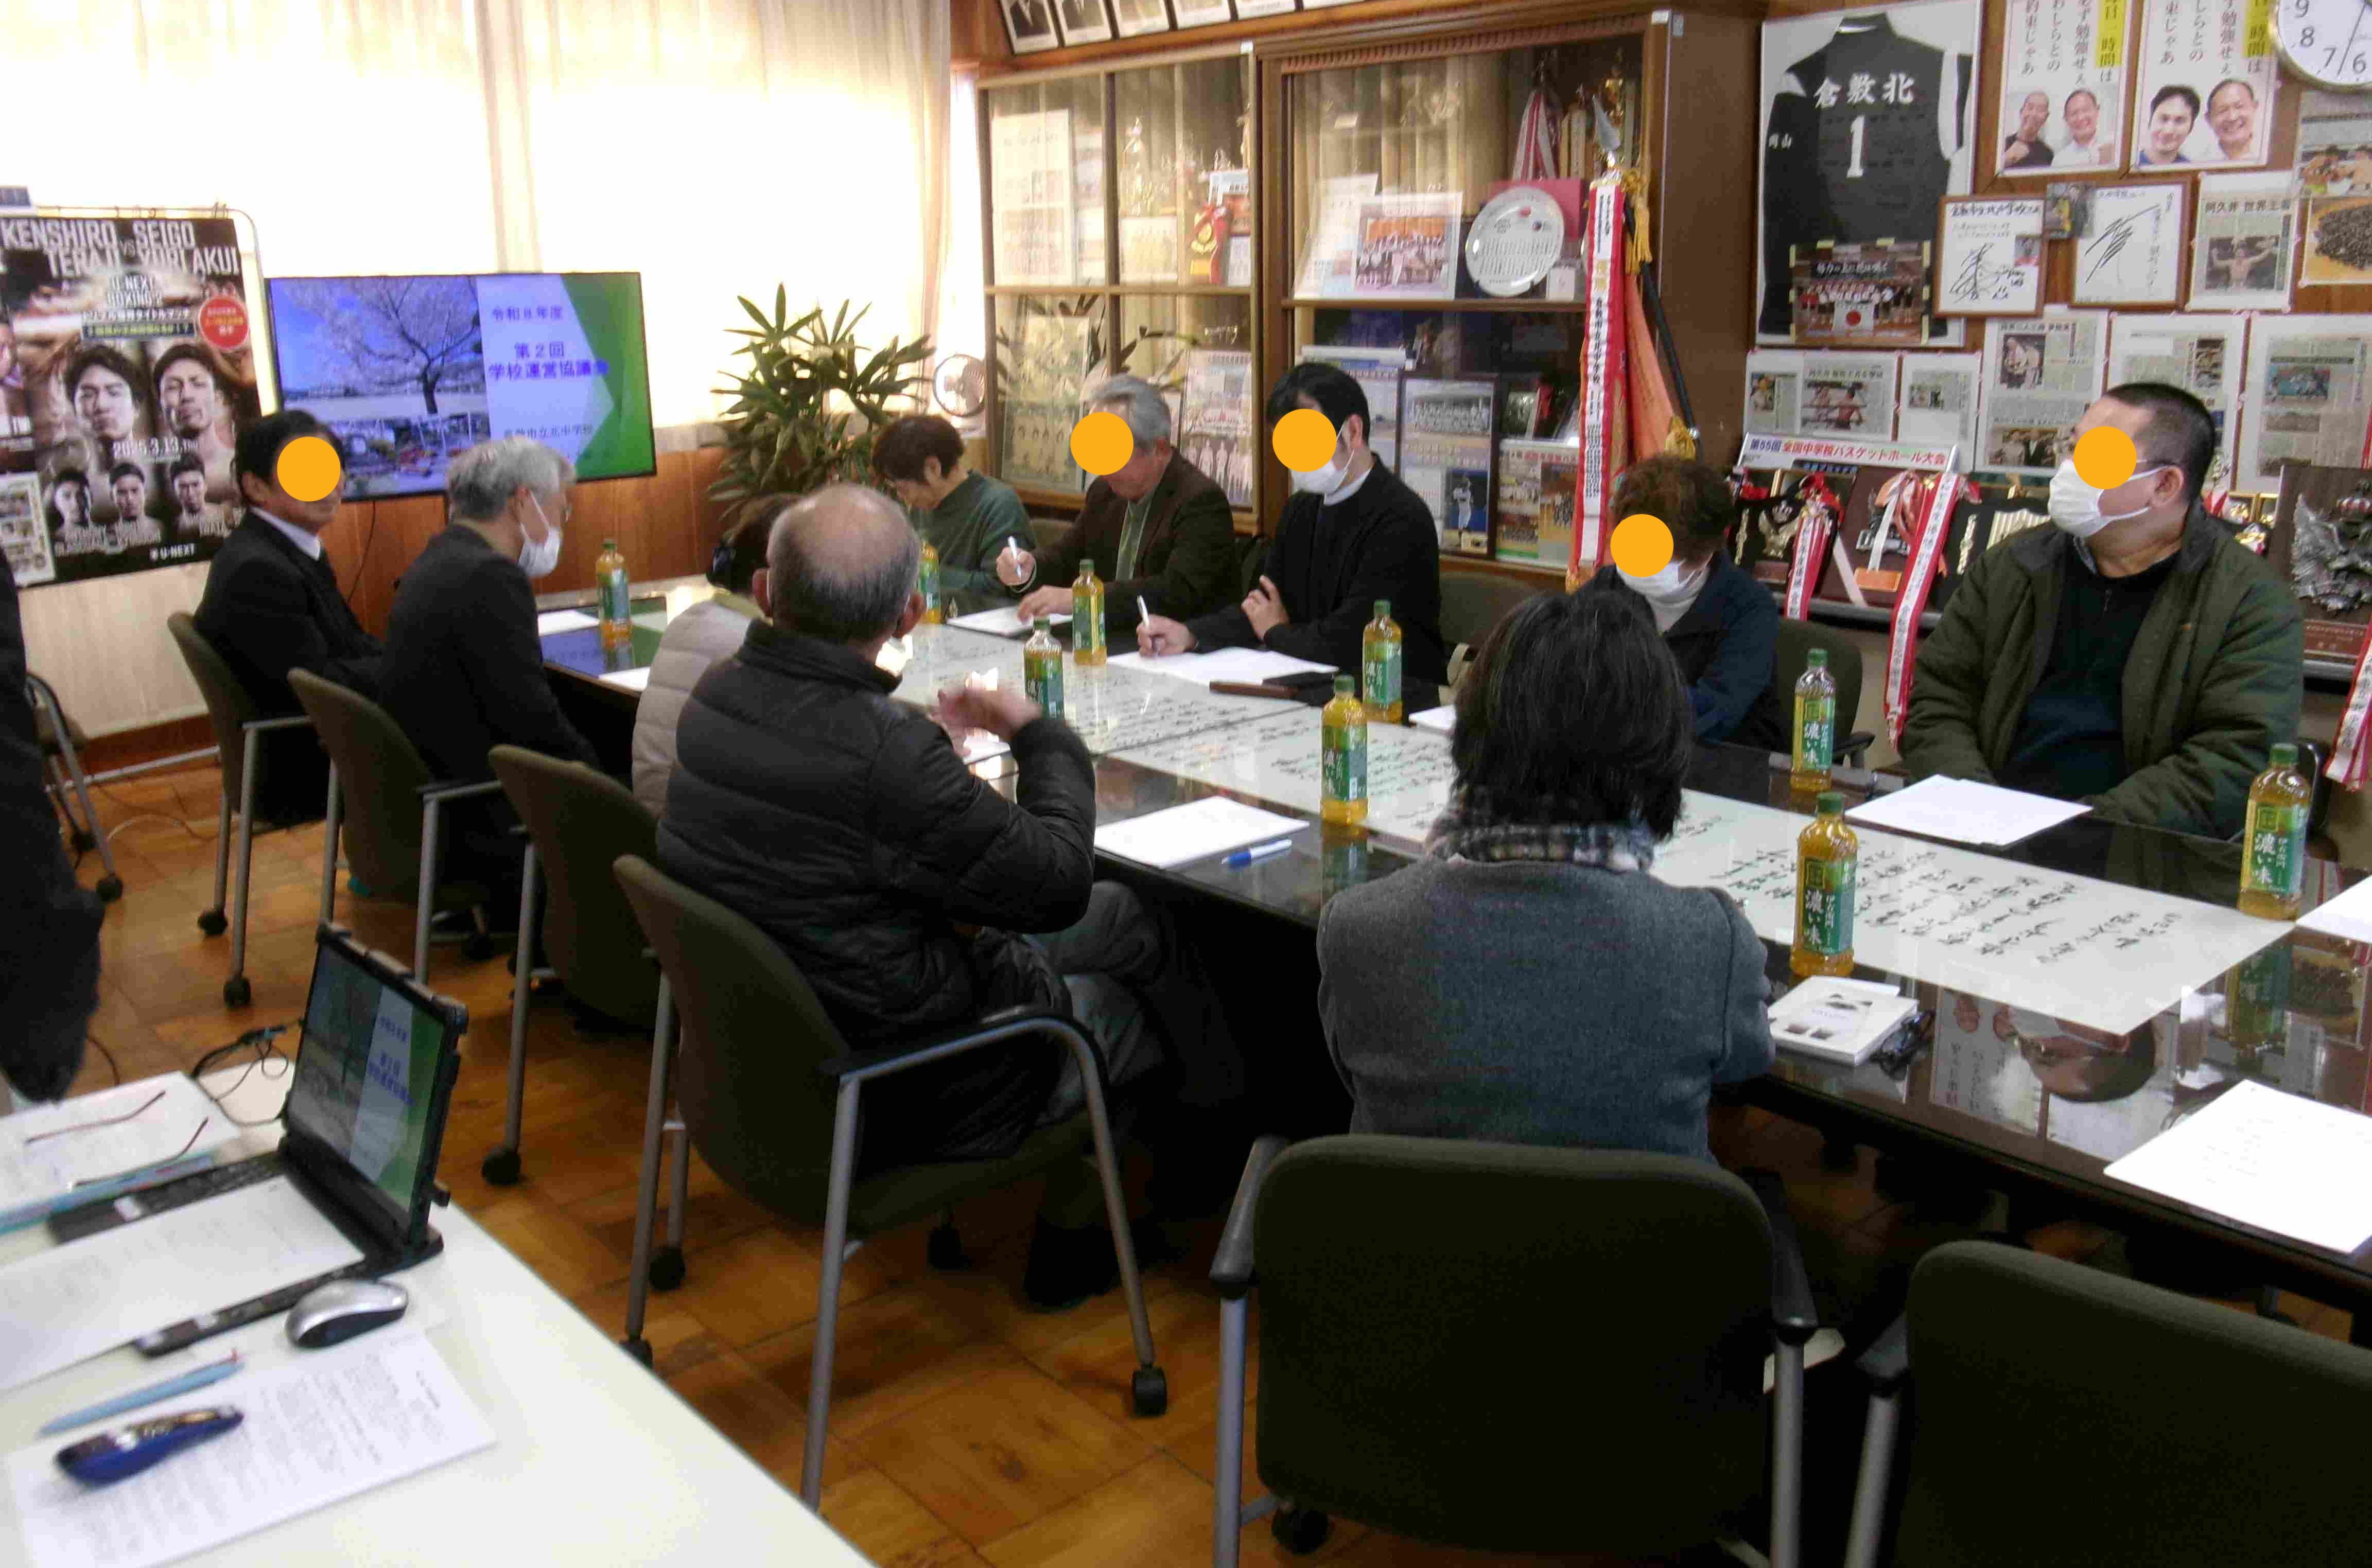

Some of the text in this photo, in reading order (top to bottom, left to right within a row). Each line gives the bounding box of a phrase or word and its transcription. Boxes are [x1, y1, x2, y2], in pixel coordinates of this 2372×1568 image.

[2295, 0, 2310, 17] 9
[2300, 26, 2314, 47] 8
[2323, 47, 2337, 68] 7
[2352, 52, 2366, 74] 6
[1813, 71, 1915, 110] 倉敷北
[1846, 115, 1866, 179] 1
[3, 220, 118, 250] KENSHIRO
[132, 220, 196, 251] SEIGO
[193, 246, 241, 276] AKUI
